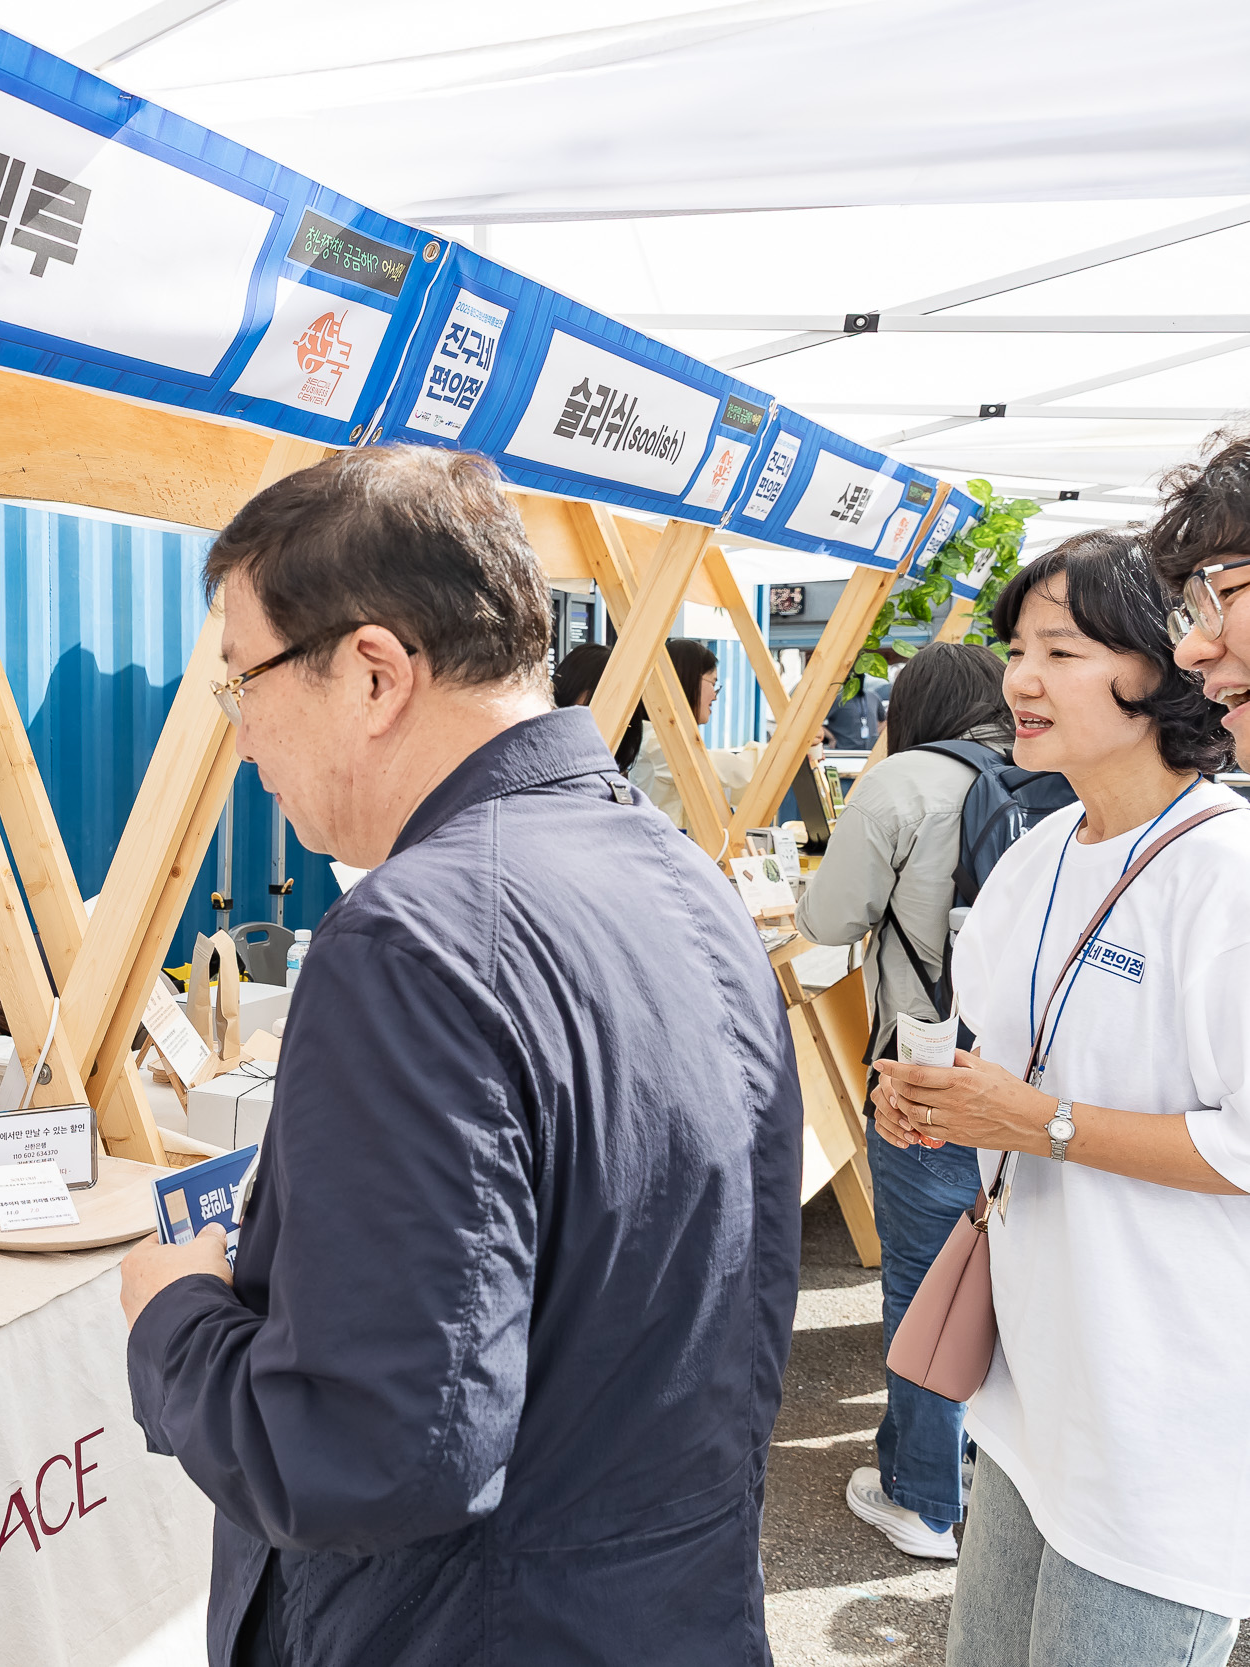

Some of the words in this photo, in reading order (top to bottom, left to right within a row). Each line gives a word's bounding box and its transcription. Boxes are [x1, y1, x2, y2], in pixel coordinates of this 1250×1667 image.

[343, 244, 379, 273] 궁금해?
[440, 322, 495, 371] 진구네
[297, 391, 325, 406] CENTER
[301, 383, 329, 398] BUSINESS
[426, 364, 484, 411] 편의점
[1100, 948, 1144, 977] 편의점
[25, 1128, 41, 1138] 만날
[43, 1127, 51, 1137] 수
[53, 1125, 68, 1135] 있는
[70, 1123, 85, 1134] 할인
[24, 1142, 47, 1151] 신한은행
